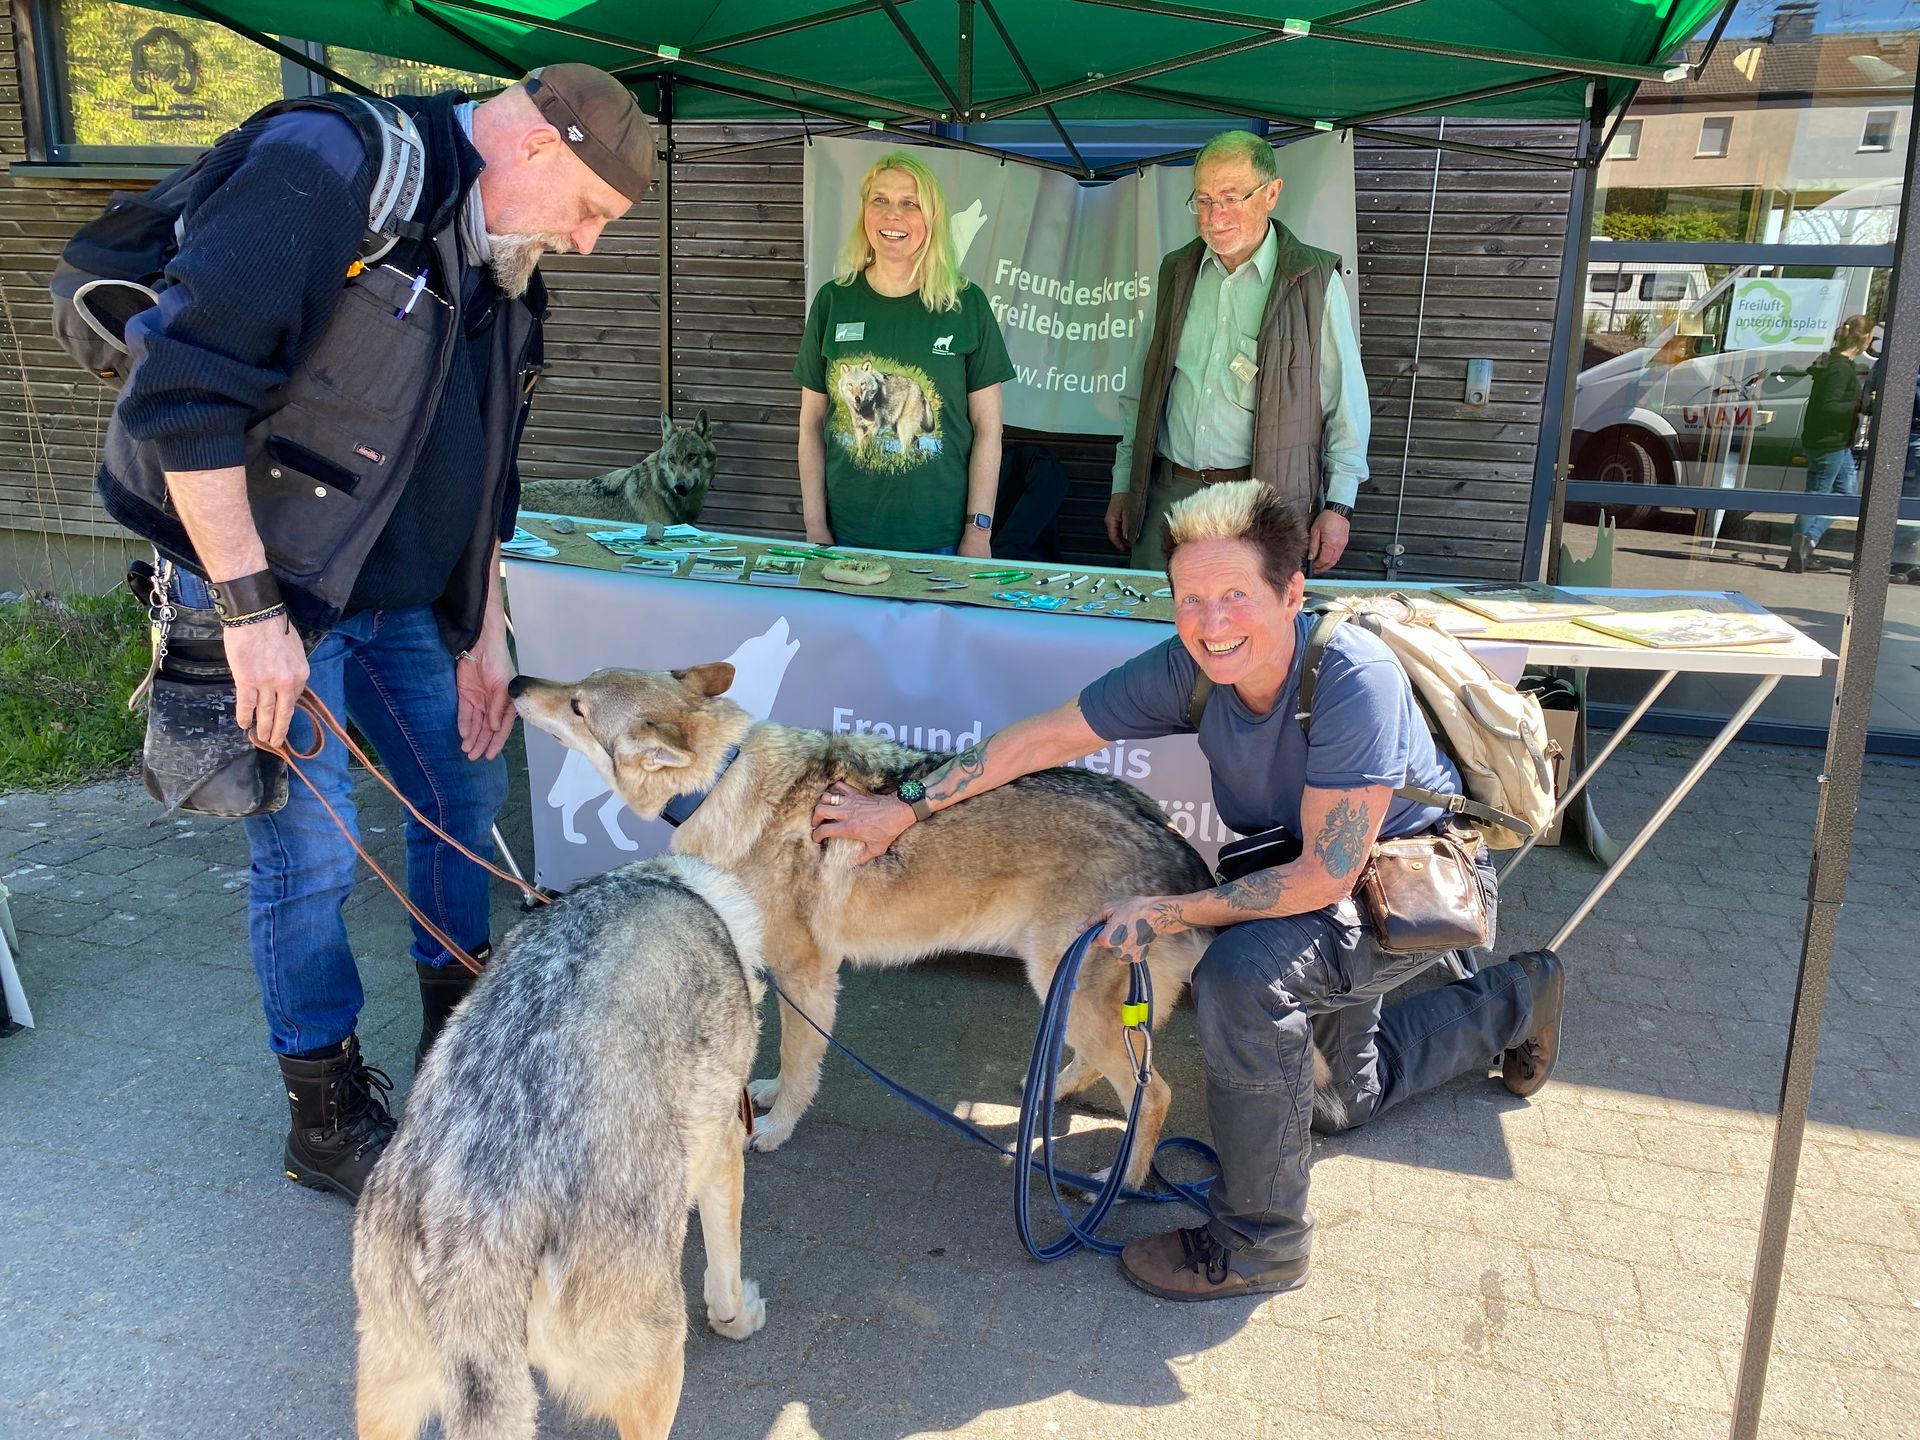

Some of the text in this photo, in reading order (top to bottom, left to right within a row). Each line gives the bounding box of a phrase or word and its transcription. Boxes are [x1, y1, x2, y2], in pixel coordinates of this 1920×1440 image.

[995, 258, 1151, 306] Freundeskreis
[990, 295, 1135, 342] freilebender
[1738, 299, 1785, 312] Freiluft-
[1736, 317, 1828, 331] unterrichtsplatz
[1012, 364, 1127, 394] w.freund
